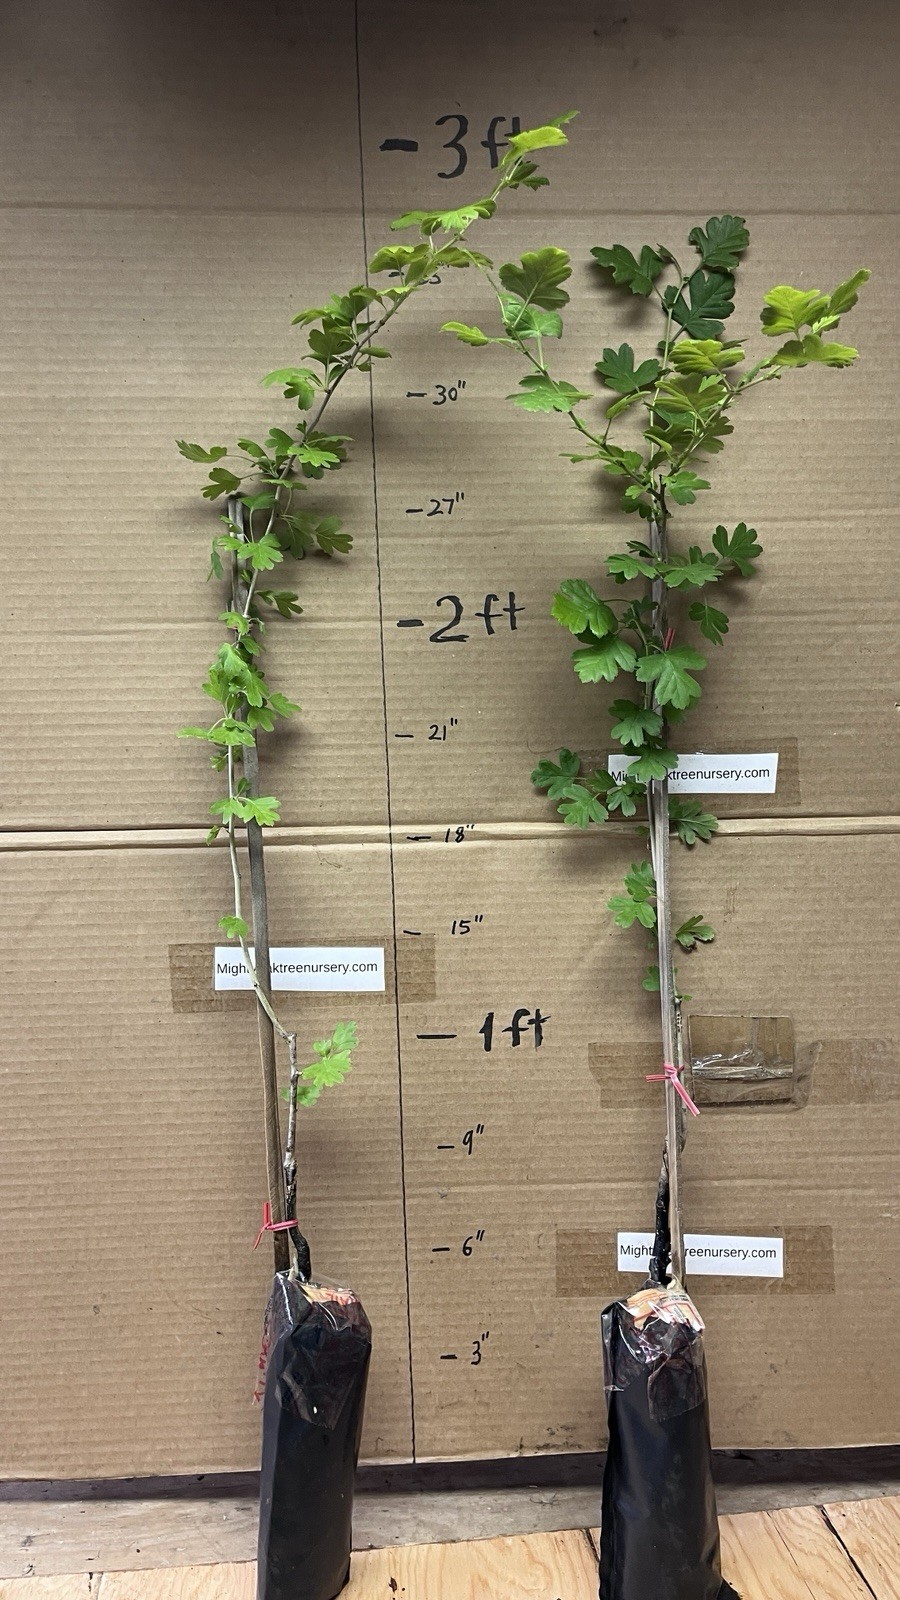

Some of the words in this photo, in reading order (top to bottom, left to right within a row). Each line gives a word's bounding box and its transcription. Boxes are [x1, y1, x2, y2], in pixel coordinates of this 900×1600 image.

[435, 114, 469, 179] 3
[432, 380, 466, 405] 30"
[427, 492, 464, 516] 27"
[428, 718, 457, 740] 21"
[445, 824, 475, 843] 18"
[451, 915, 483, 935] 15"
[217, 962, 378, 976] Mighktreenursery.com
[462, 1124, 484, 1155] 9"
[462, 1230, 485, 1256] 6"
[620, 1245, 777, 1261] Mightreenursery.com
[471, 1331, 489, 1365] 3"
